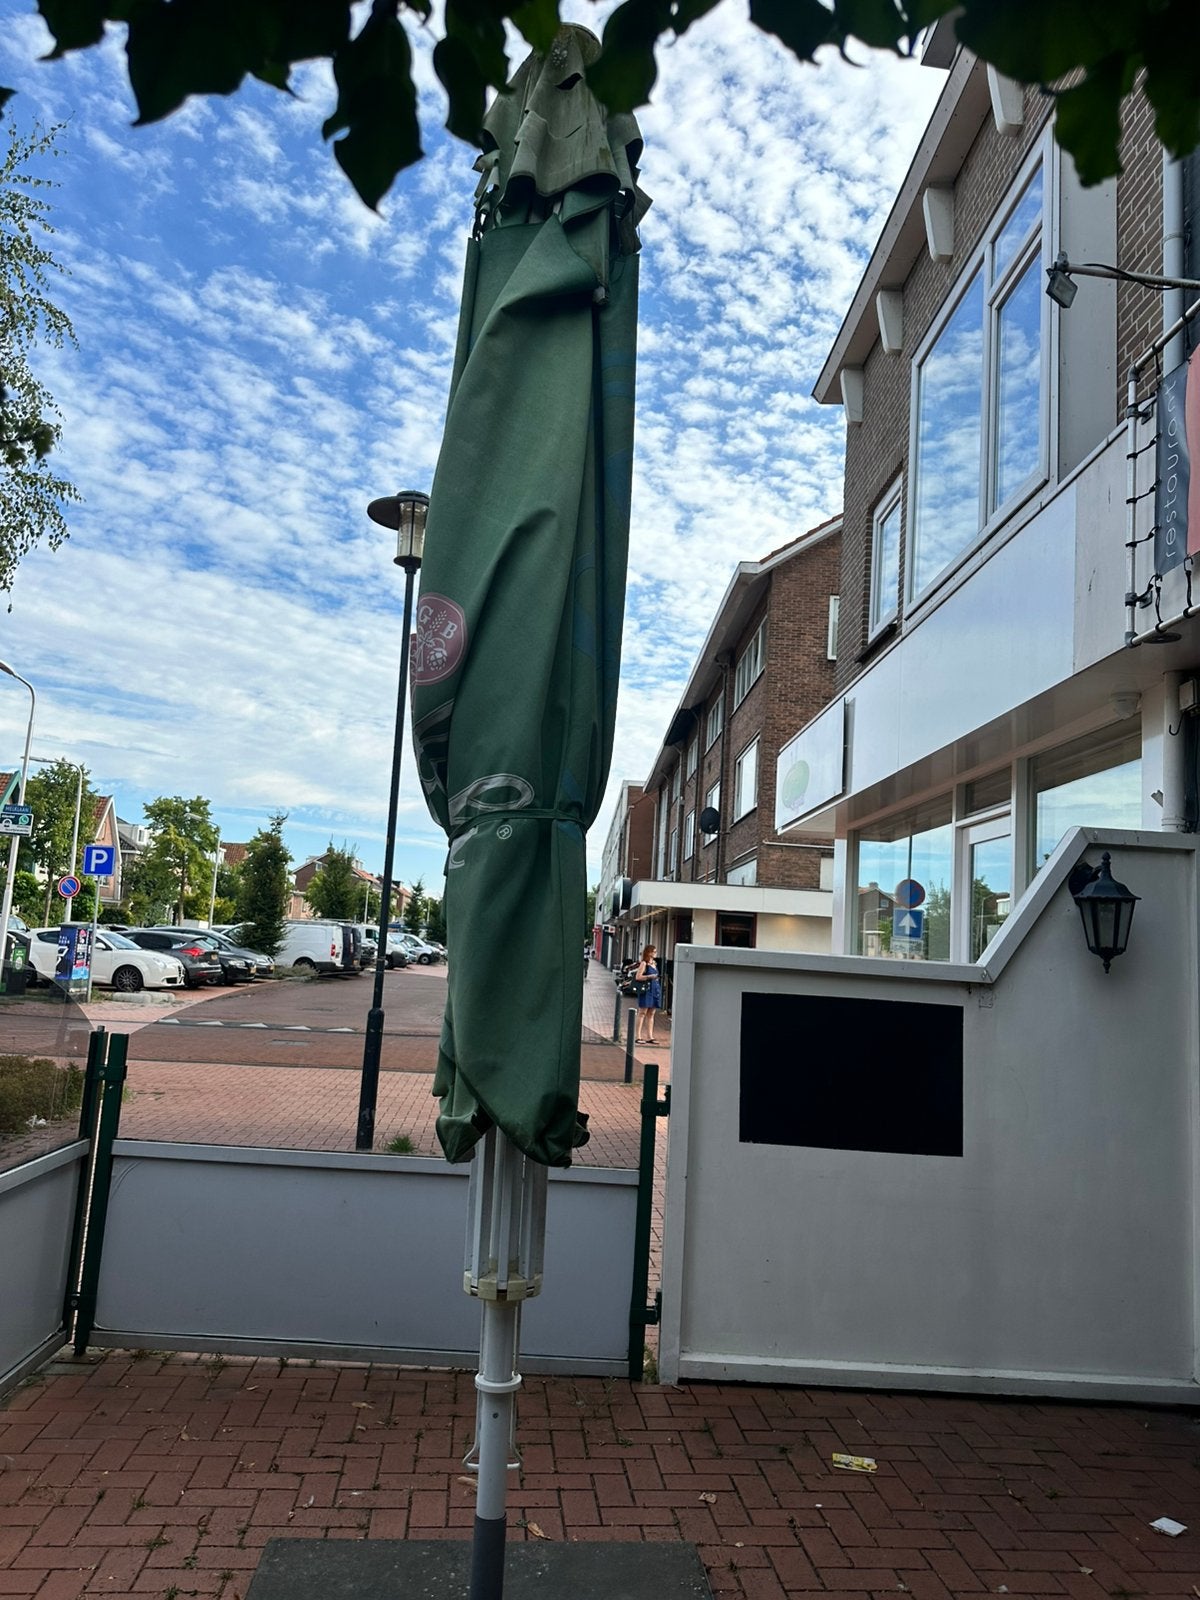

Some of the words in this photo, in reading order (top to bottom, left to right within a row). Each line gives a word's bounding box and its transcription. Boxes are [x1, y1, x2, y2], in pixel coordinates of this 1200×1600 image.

[1163, 380, 1179, 558] restaurant
[440, 620, 458, 639] B
[90, 849, 109, 872] P
